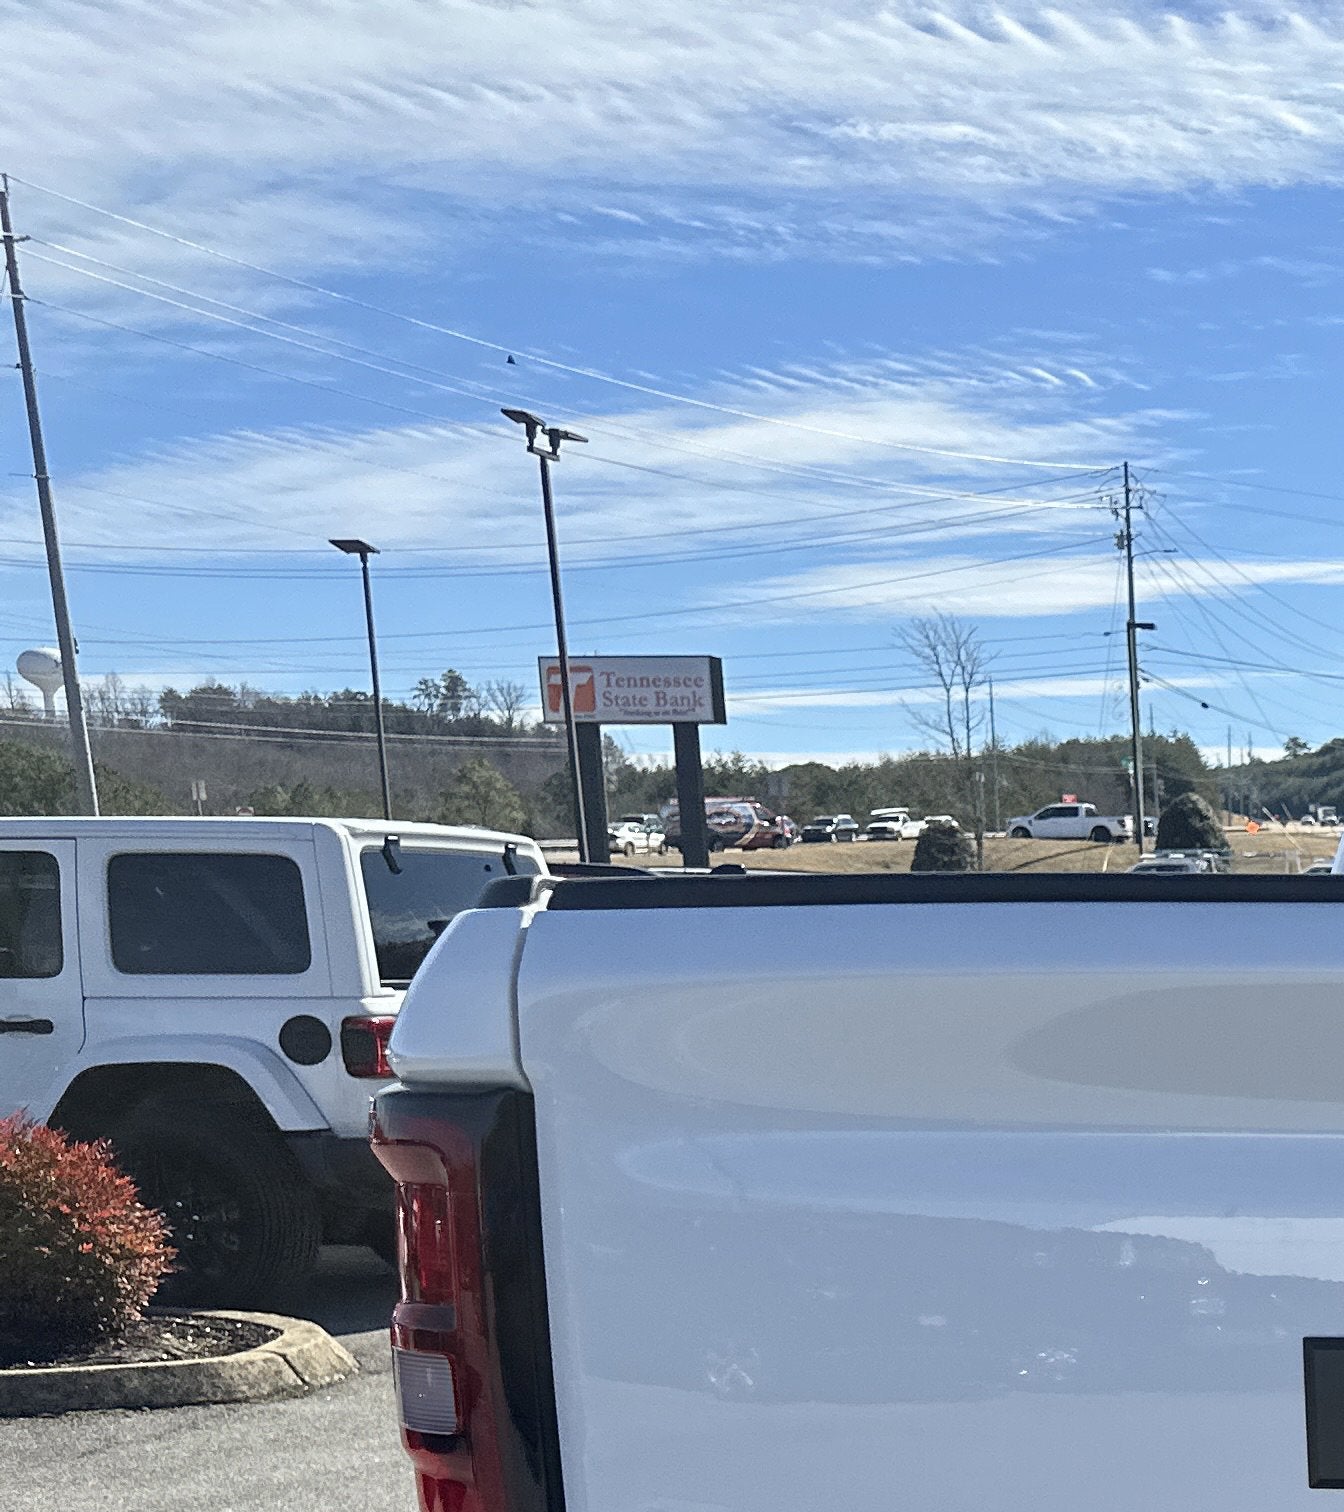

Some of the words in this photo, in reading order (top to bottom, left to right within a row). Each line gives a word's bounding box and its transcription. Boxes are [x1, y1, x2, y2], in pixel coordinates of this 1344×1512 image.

[600, 671, 704, 688] Tennessee
[602, 690, 648, 707] State
[654, 690, 705, 707] Bank
